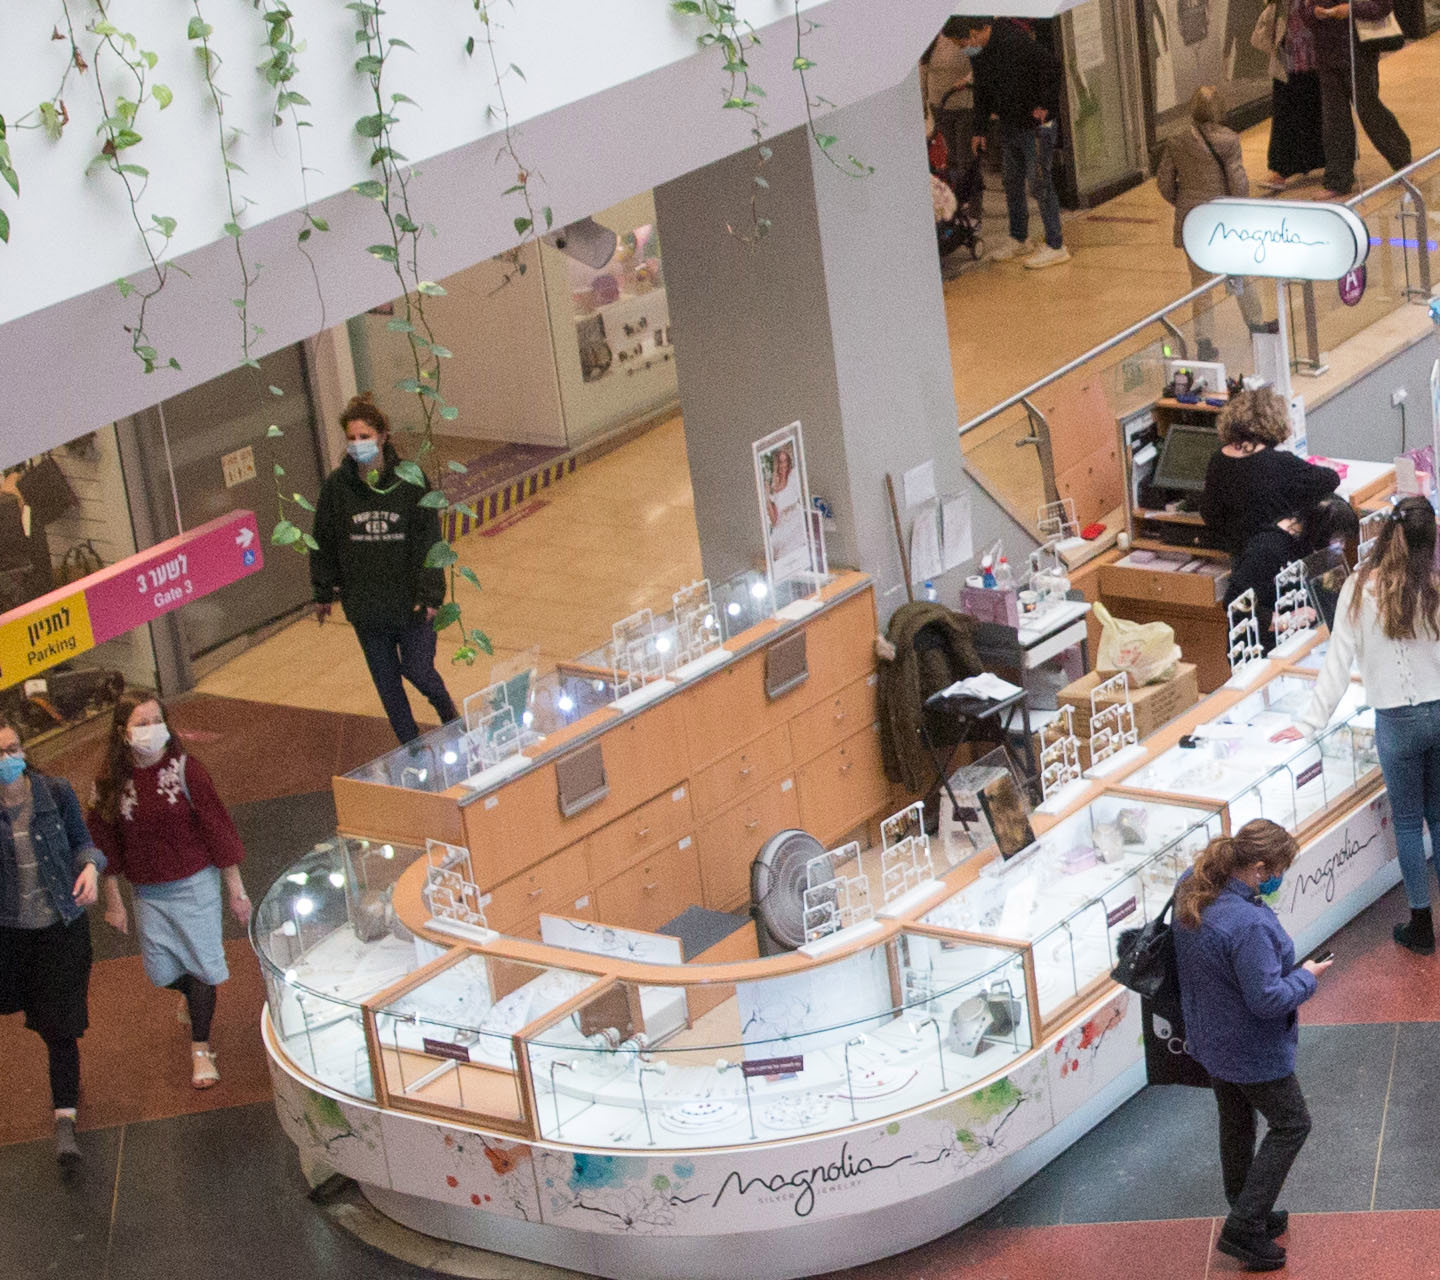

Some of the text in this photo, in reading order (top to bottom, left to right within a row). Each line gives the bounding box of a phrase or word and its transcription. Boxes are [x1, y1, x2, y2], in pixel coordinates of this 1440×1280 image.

[136, 553, 189, 595] לשער 3
[153, 579, 194, 609] Gate 3
[26, 606, 71, 648] לחניון
[27, 634, 77, 666] Parking
